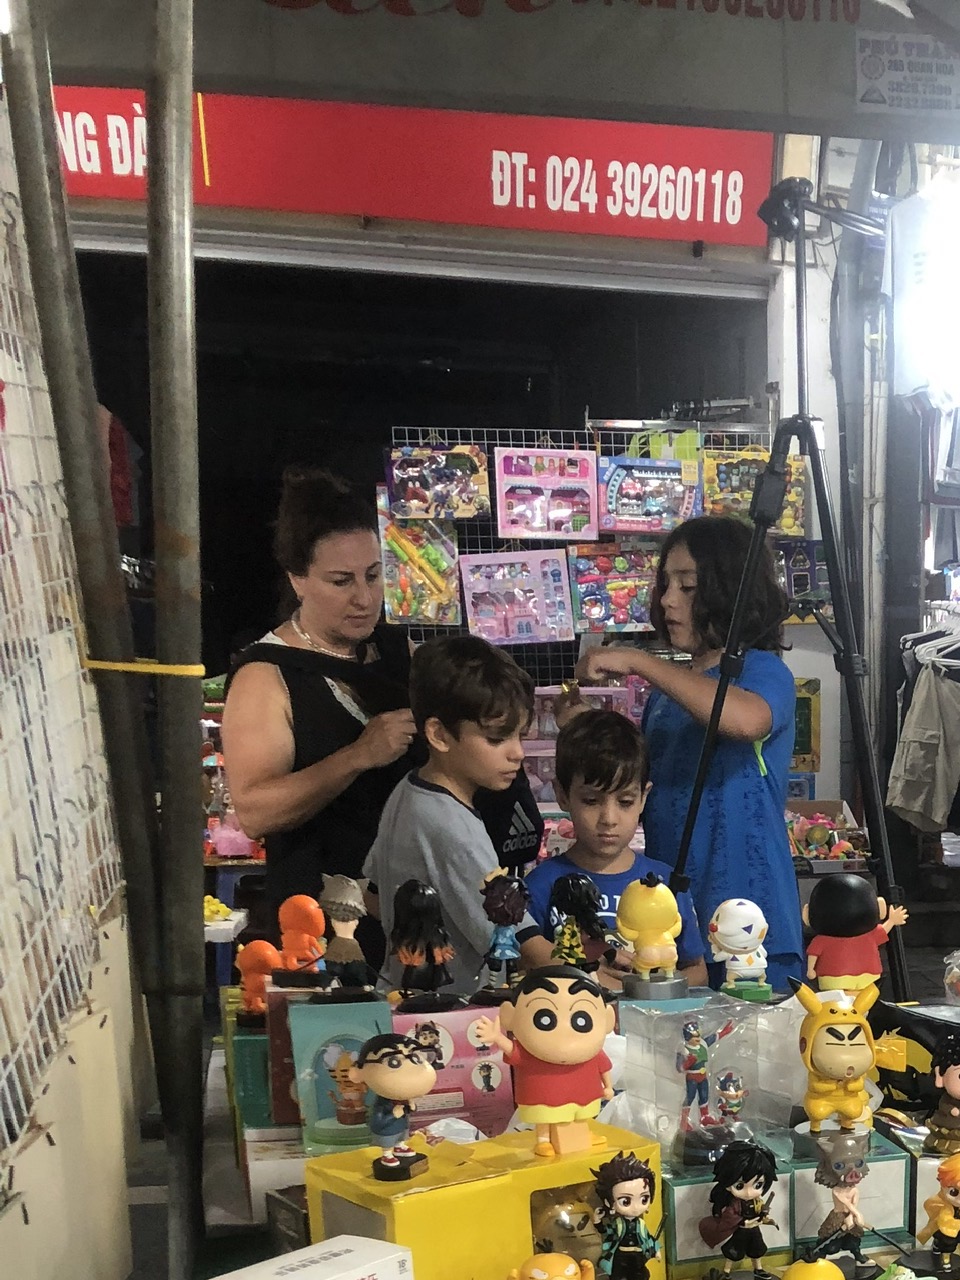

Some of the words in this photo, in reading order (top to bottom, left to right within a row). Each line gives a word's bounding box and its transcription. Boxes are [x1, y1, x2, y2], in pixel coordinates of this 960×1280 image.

[56, 111, 102, 174] NG
[106, 103, 149, 177] ĐÀ
[491, 149, 536, 209] ĐT:
[545, 155, 598, 214] 024
[606, 160, 744, 225] 39260118
[502, 831, 538, 853] adidas
